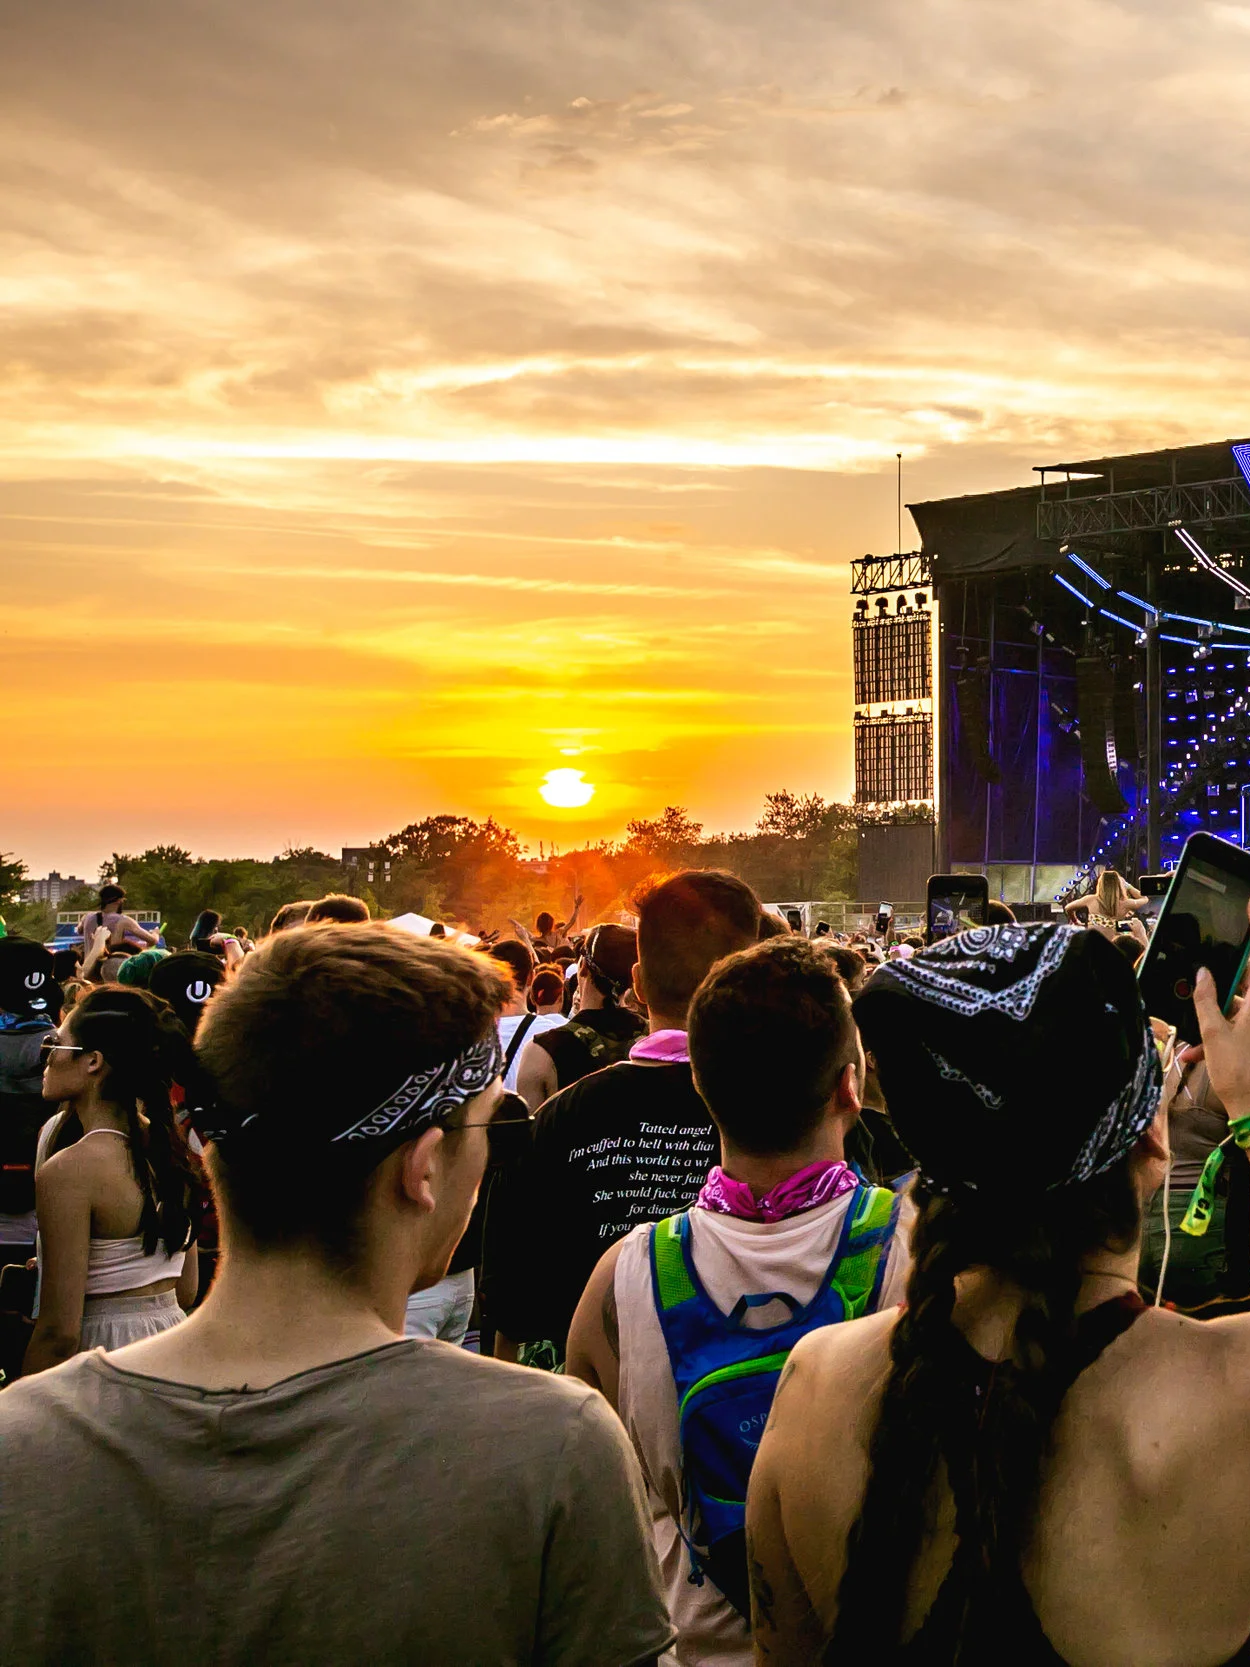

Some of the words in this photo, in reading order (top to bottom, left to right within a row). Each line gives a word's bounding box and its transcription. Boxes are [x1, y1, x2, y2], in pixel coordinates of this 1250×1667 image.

[640, 1122, 677, 1134] Tatted
[679, 1125, 712, 1137] angel
[587, 1137, 621, 1153] cuffed
[623, 1139, 635, 1147] to
[639, 1138, 662, 1149] hell
[666, 1141, 689, 1150] with
[693, 1141, 714, 1151] dia
[587, 1155, 609, 1171] And
[612, 1154, 631, 1165] this
[636, 1155, 669, 1165] world
[672, 1157, 680, 1165] is
[629, 1170, 648, 1180] she
[651, 1173, 682, 1183] never
[681, 1173, 706, 1186] fait
[593, 1190, 613, 1203] She
[616, 1187, 651, 1198] would
[650, 1188, 678, 1201] fuck
[626, 1204, 645, 1217] for
[599, 1223, 611, 1239] If
[610, 1223, 631, 1236] you
